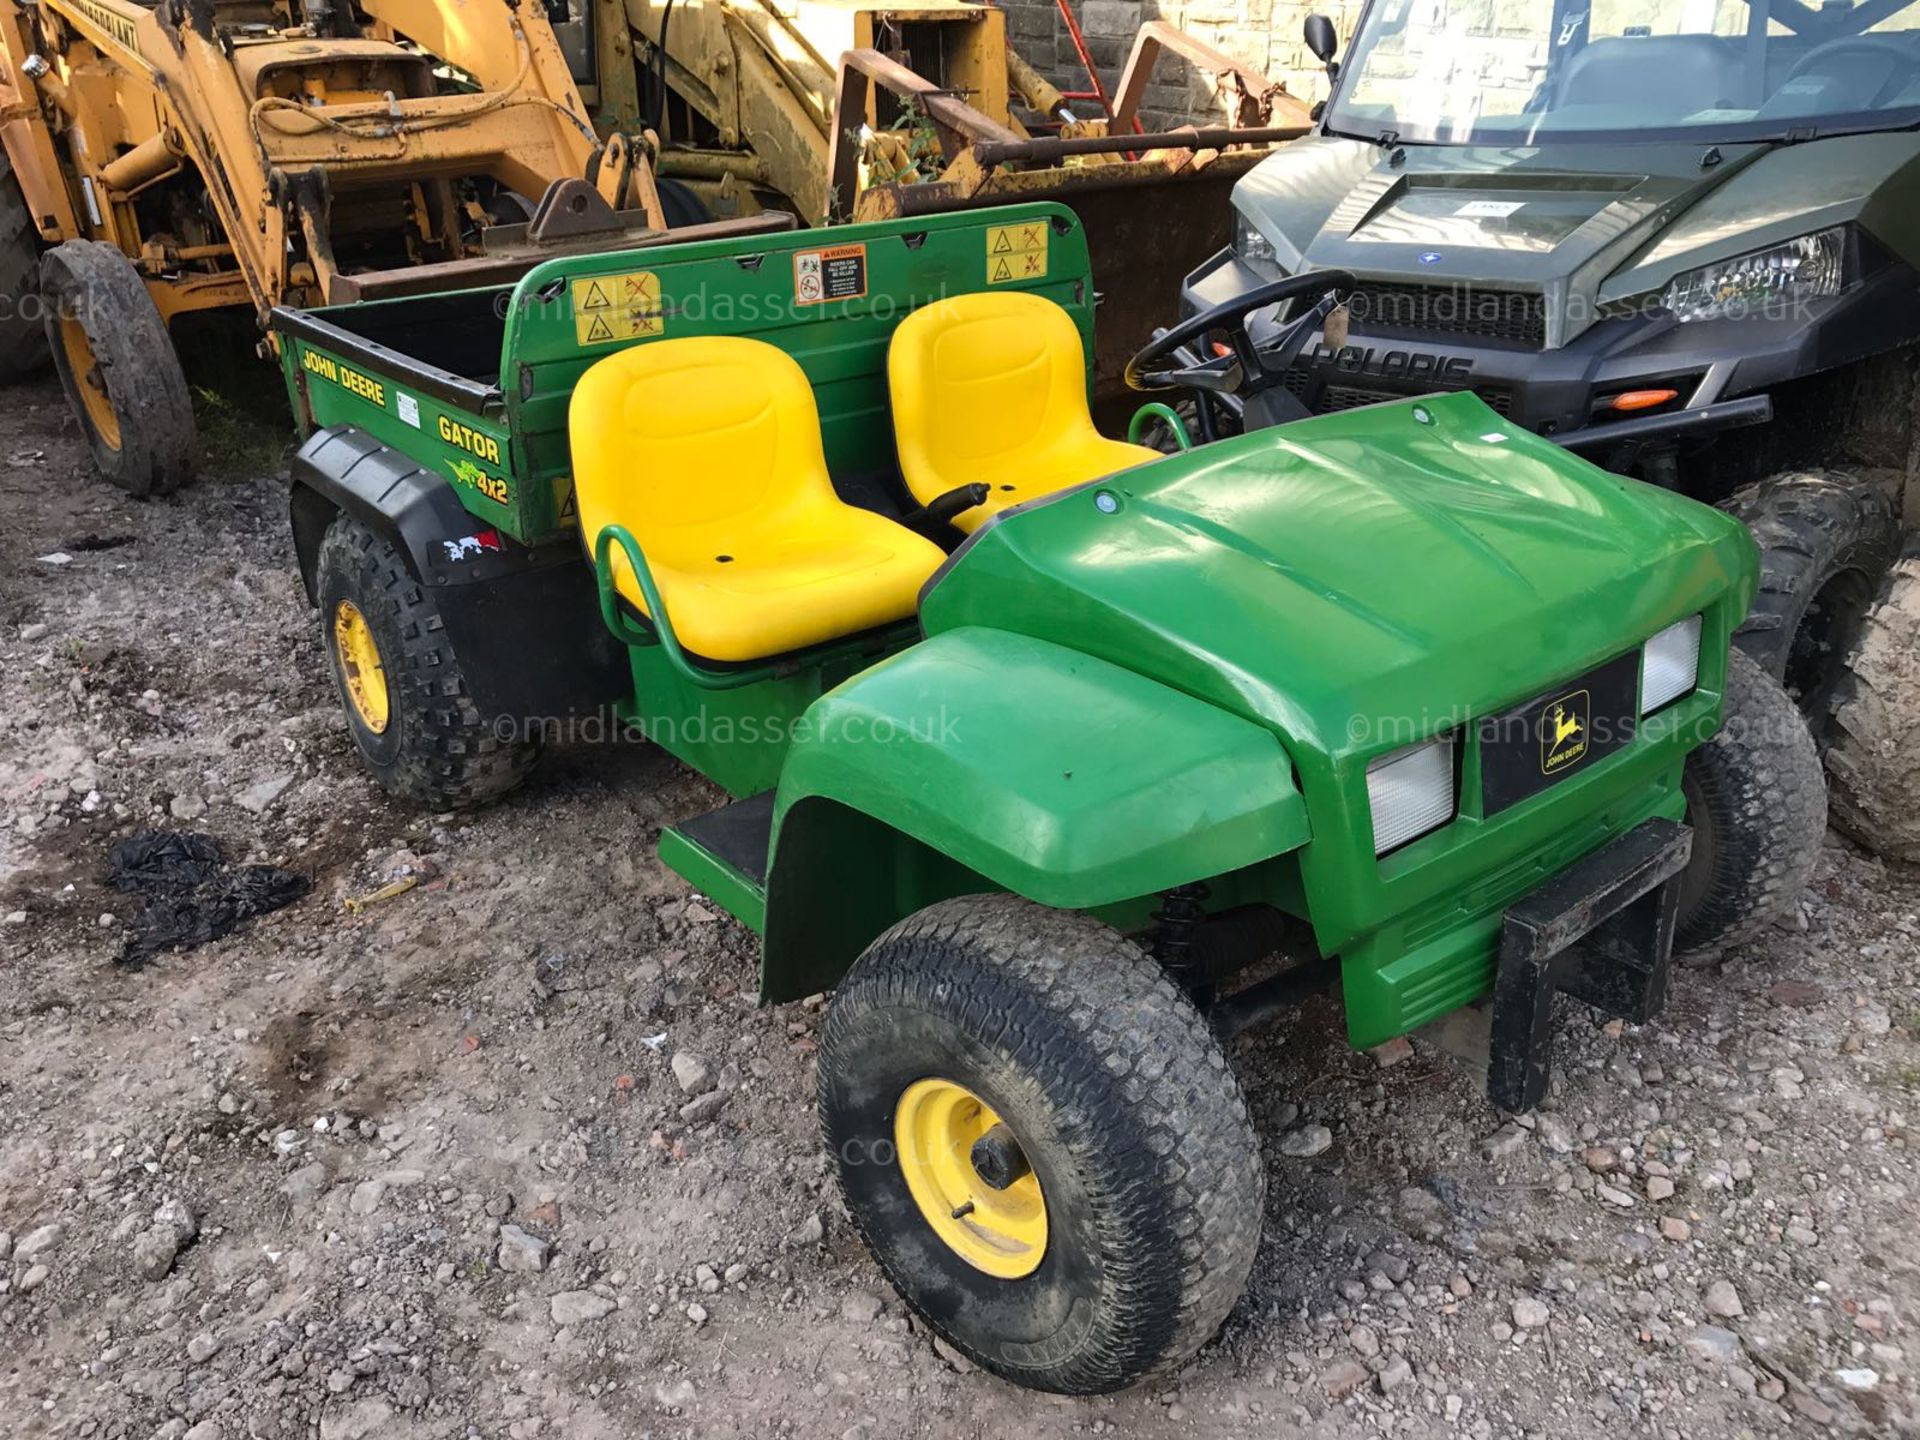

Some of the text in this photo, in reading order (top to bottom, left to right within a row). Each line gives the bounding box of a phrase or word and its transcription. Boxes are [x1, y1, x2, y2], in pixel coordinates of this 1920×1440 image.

[831, 247, 861, 256] WARNING
[304, 350, 385, 406] JOHN DEERE
[1311, 343, 1474, 383] POLARIS
[438, 415, 500, 465] GATOR
[476, 469, 508, 504] 4x2
[1546, 741, 1585, 768] JOHN DEERE
